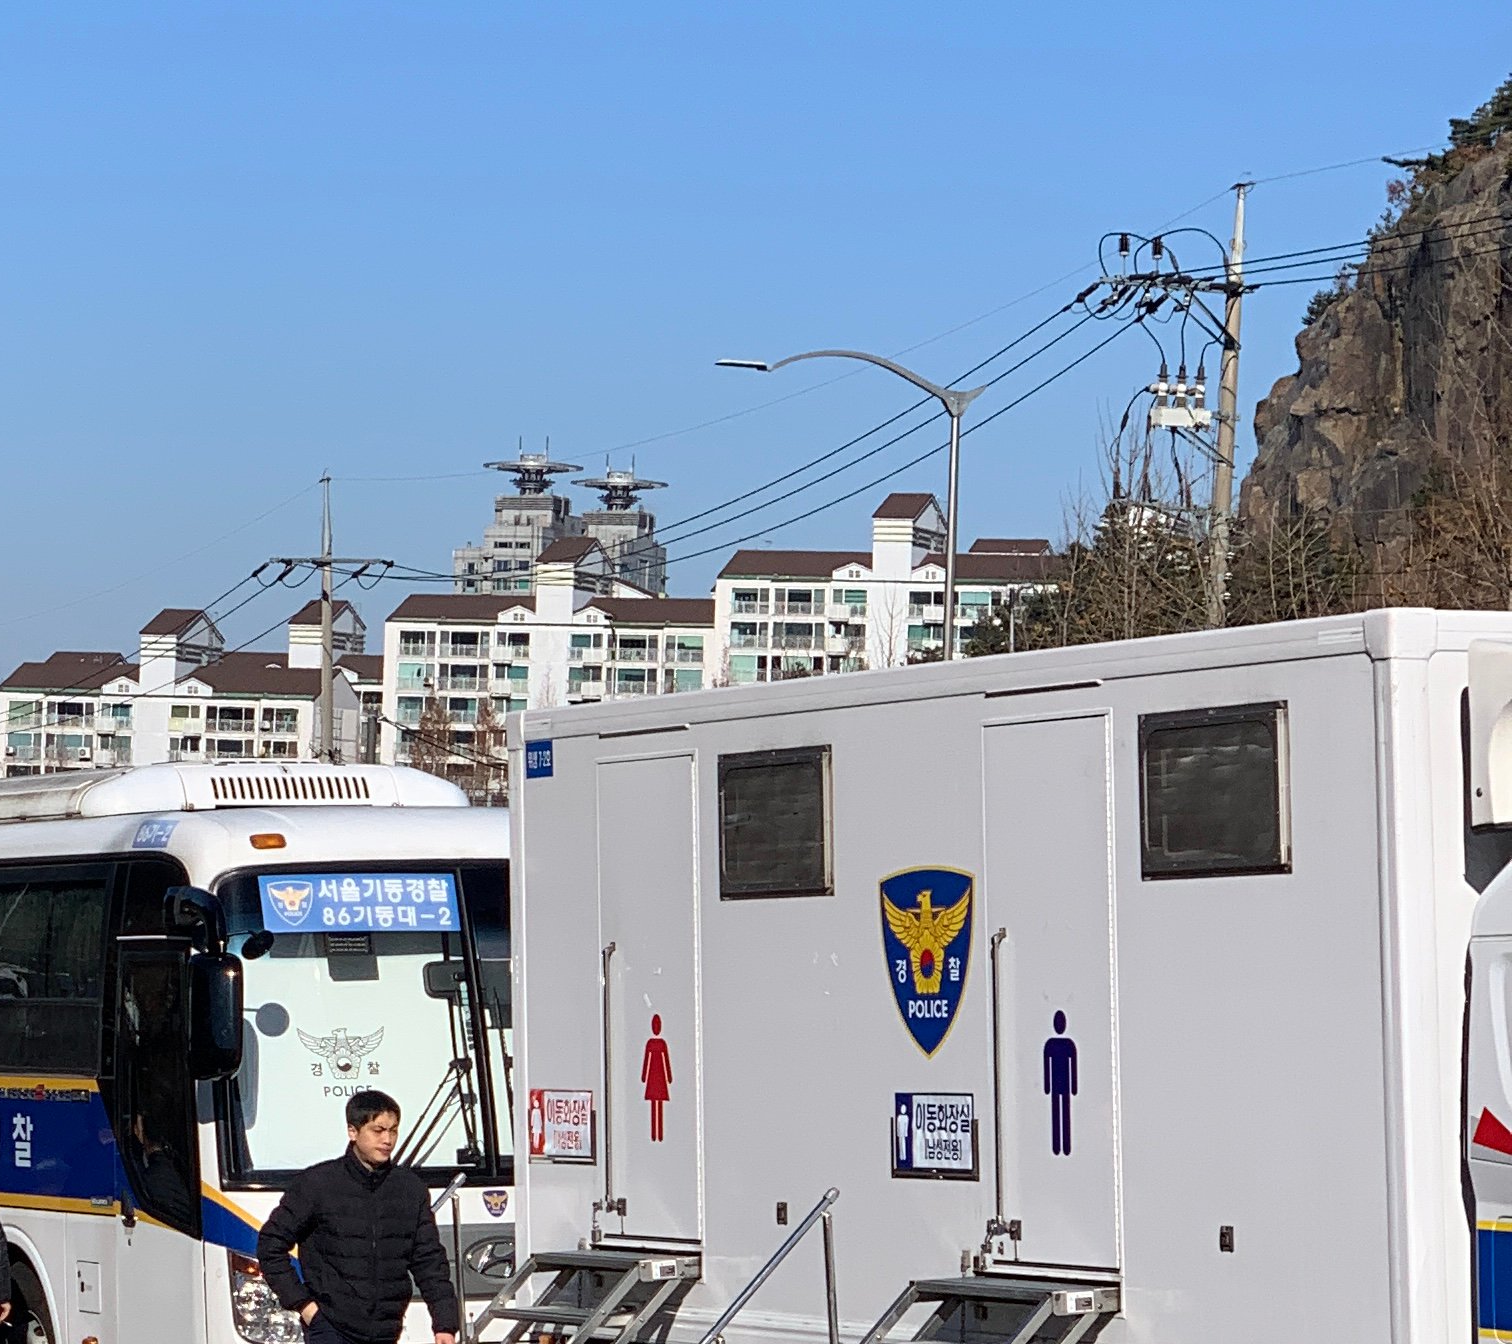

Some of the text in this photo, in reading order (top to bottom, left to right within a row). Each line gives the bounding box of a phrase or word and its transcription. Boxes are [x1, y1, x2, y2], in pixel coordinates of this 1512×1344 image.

[318, 878, 448, 903] 서울기동경찰
[322, 907, 452, 927] 86기동대-2
[896, 957, 961, 983] 경 찰
[908, 1000, 949, 1018] POLICE
[915, 1103, 970, 1133] 이동화장실
